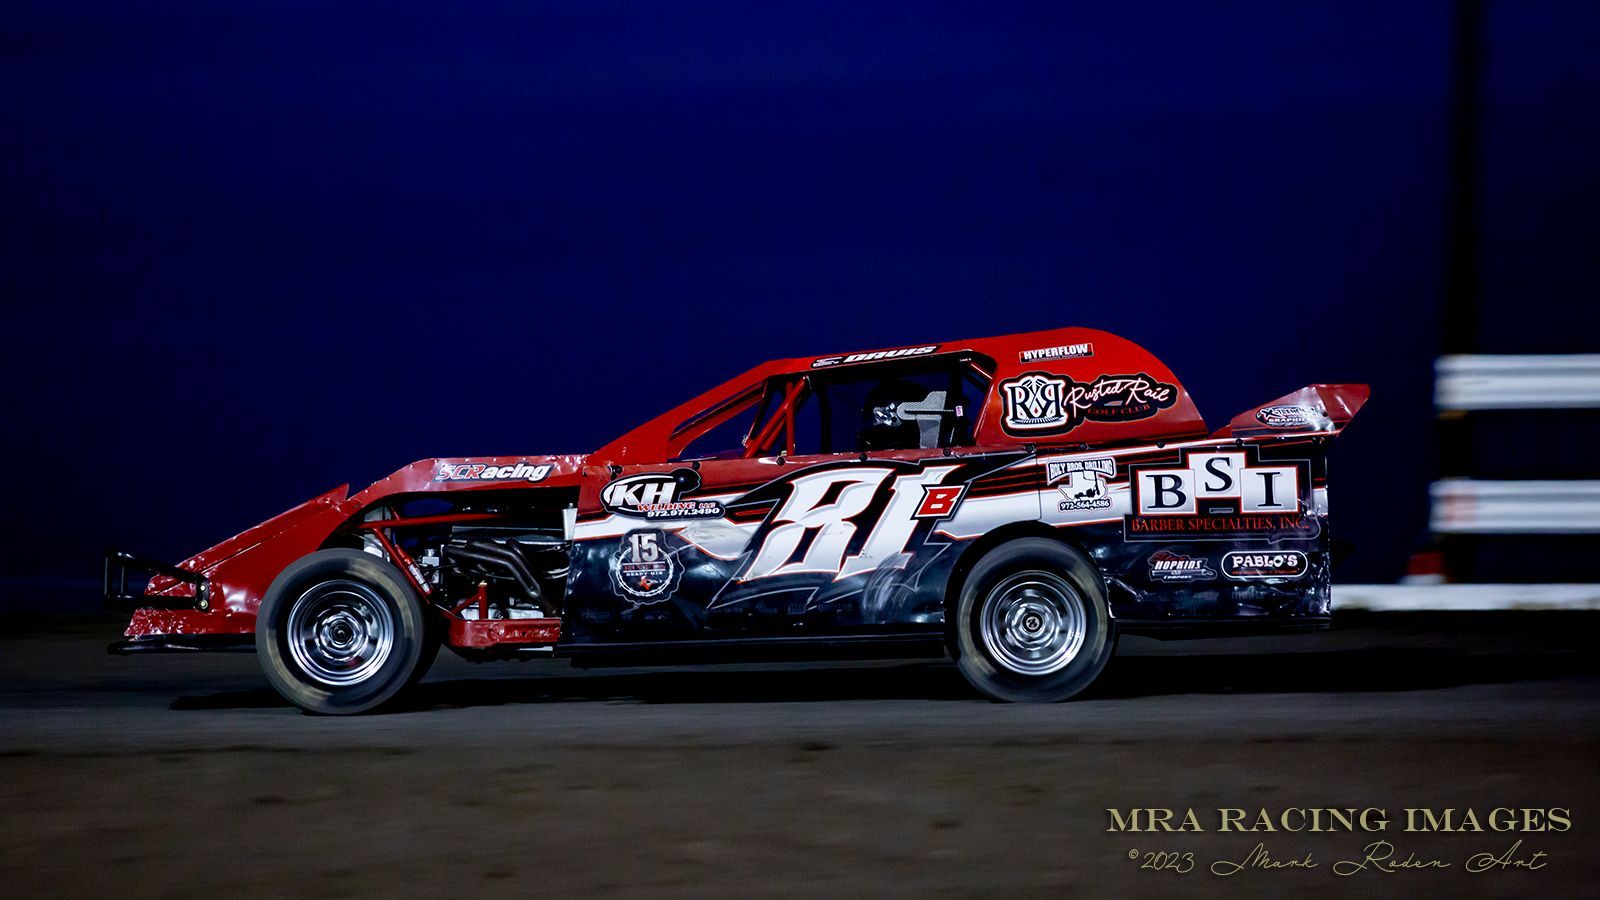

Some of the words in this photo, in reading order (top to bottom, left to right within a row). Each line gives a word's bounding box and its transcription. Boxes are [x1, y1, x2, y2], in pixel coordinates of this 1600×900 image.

[843, 346, 937, 362] DAVIS
[1023, 344, 1088, 360] HYPERFLOW
[1063, 379, 1125, 418] Rusted
[1122, 377, 1169, 406] Rail
[435, 464, 551, 481] SCRacing
[609, 482, 677, 506] KH
[637, 502, 696, 512] WELDING
[647, 507, 720, 518] 972.971.2490
[1060, 501, 1110, 510] 972-564-4586
[738, 466, 967, 583] 81
[1131, 518, 1185, 532] BARBER
[1188, 516, 1277, 531] SPECIALTIES,
[1280, 516, 1310, 530] INC.
[628, 533, 659, 562] 15
[1154, 560, 1203, 570] HOPKINS
[1232, 554, 1298, 568] PABLO'S
